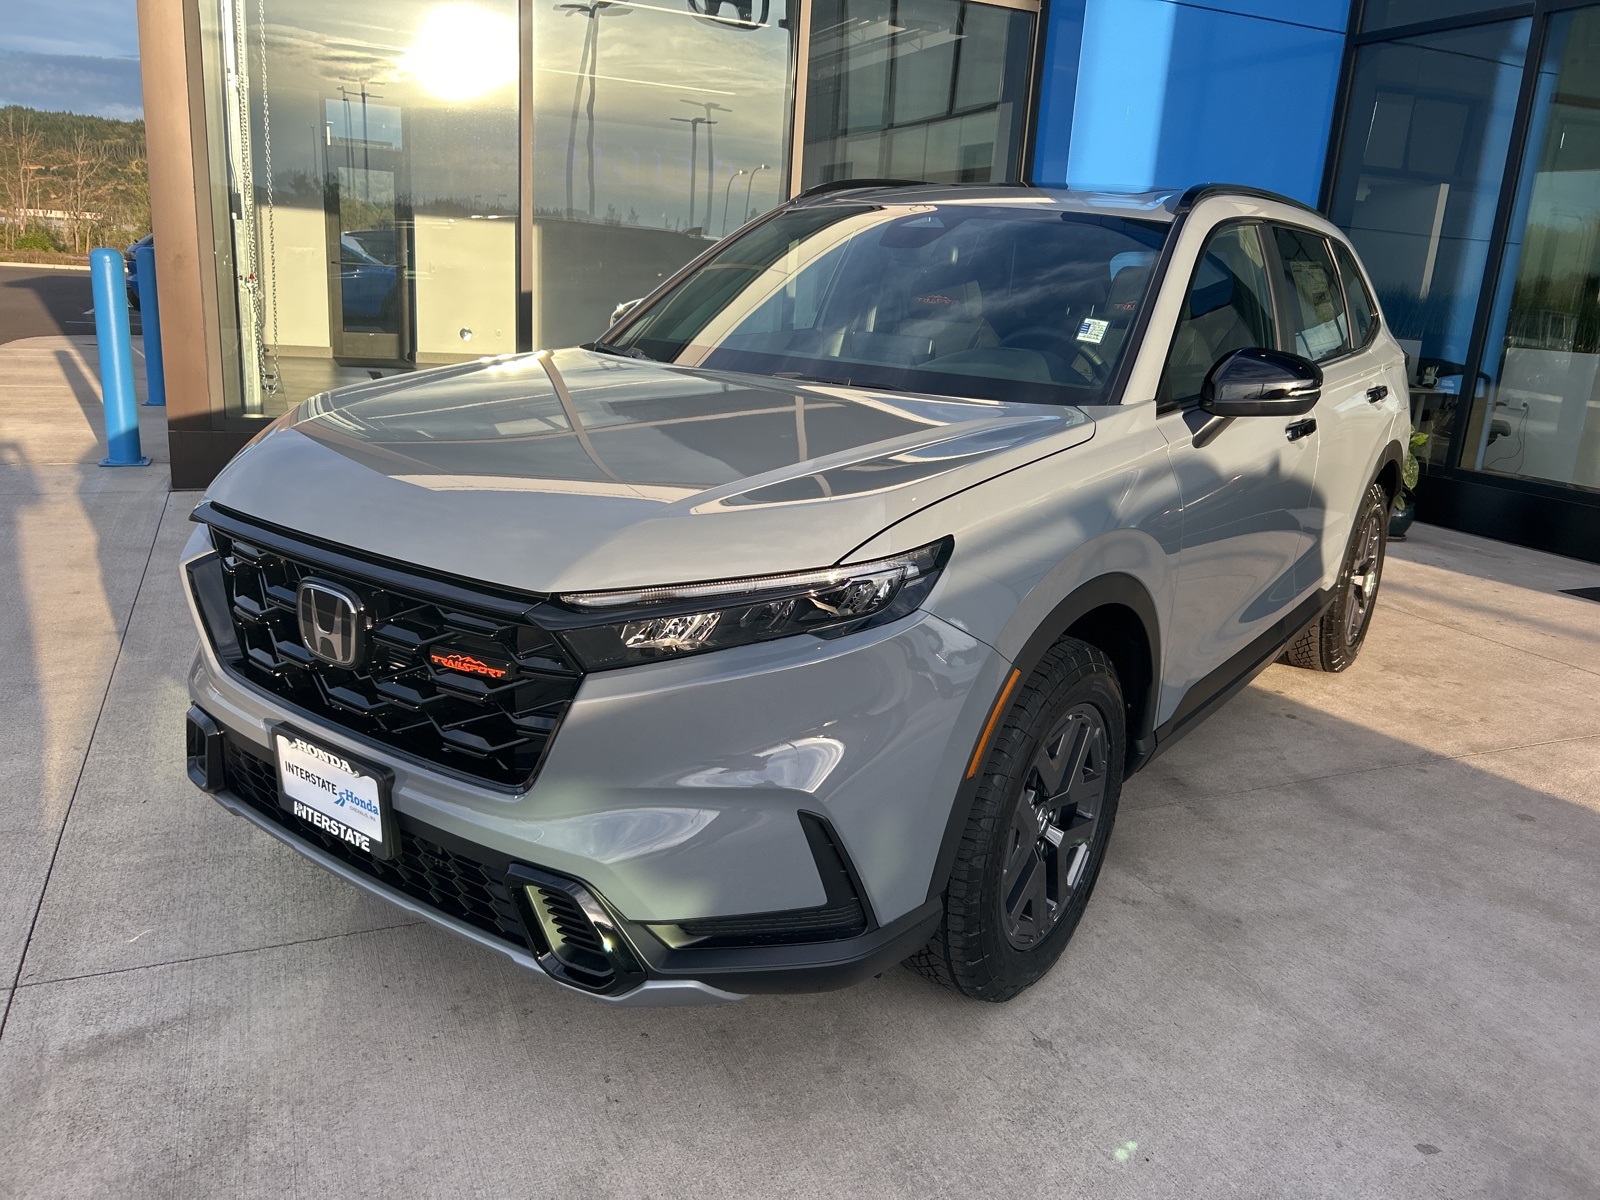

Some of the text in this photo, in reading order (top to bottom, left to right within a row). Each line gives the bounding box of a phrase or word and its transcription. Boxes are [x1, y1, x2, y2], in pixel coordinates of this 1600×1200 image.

[431, 654, 506, 678] TRAILSPORT
[295, 738, 354, 775] HONDA
[285, 760, 338, 796] INTERSTATE
[344, 788, 379, 816] Honda
[293, 800, 371, 853] INTERSTATE
